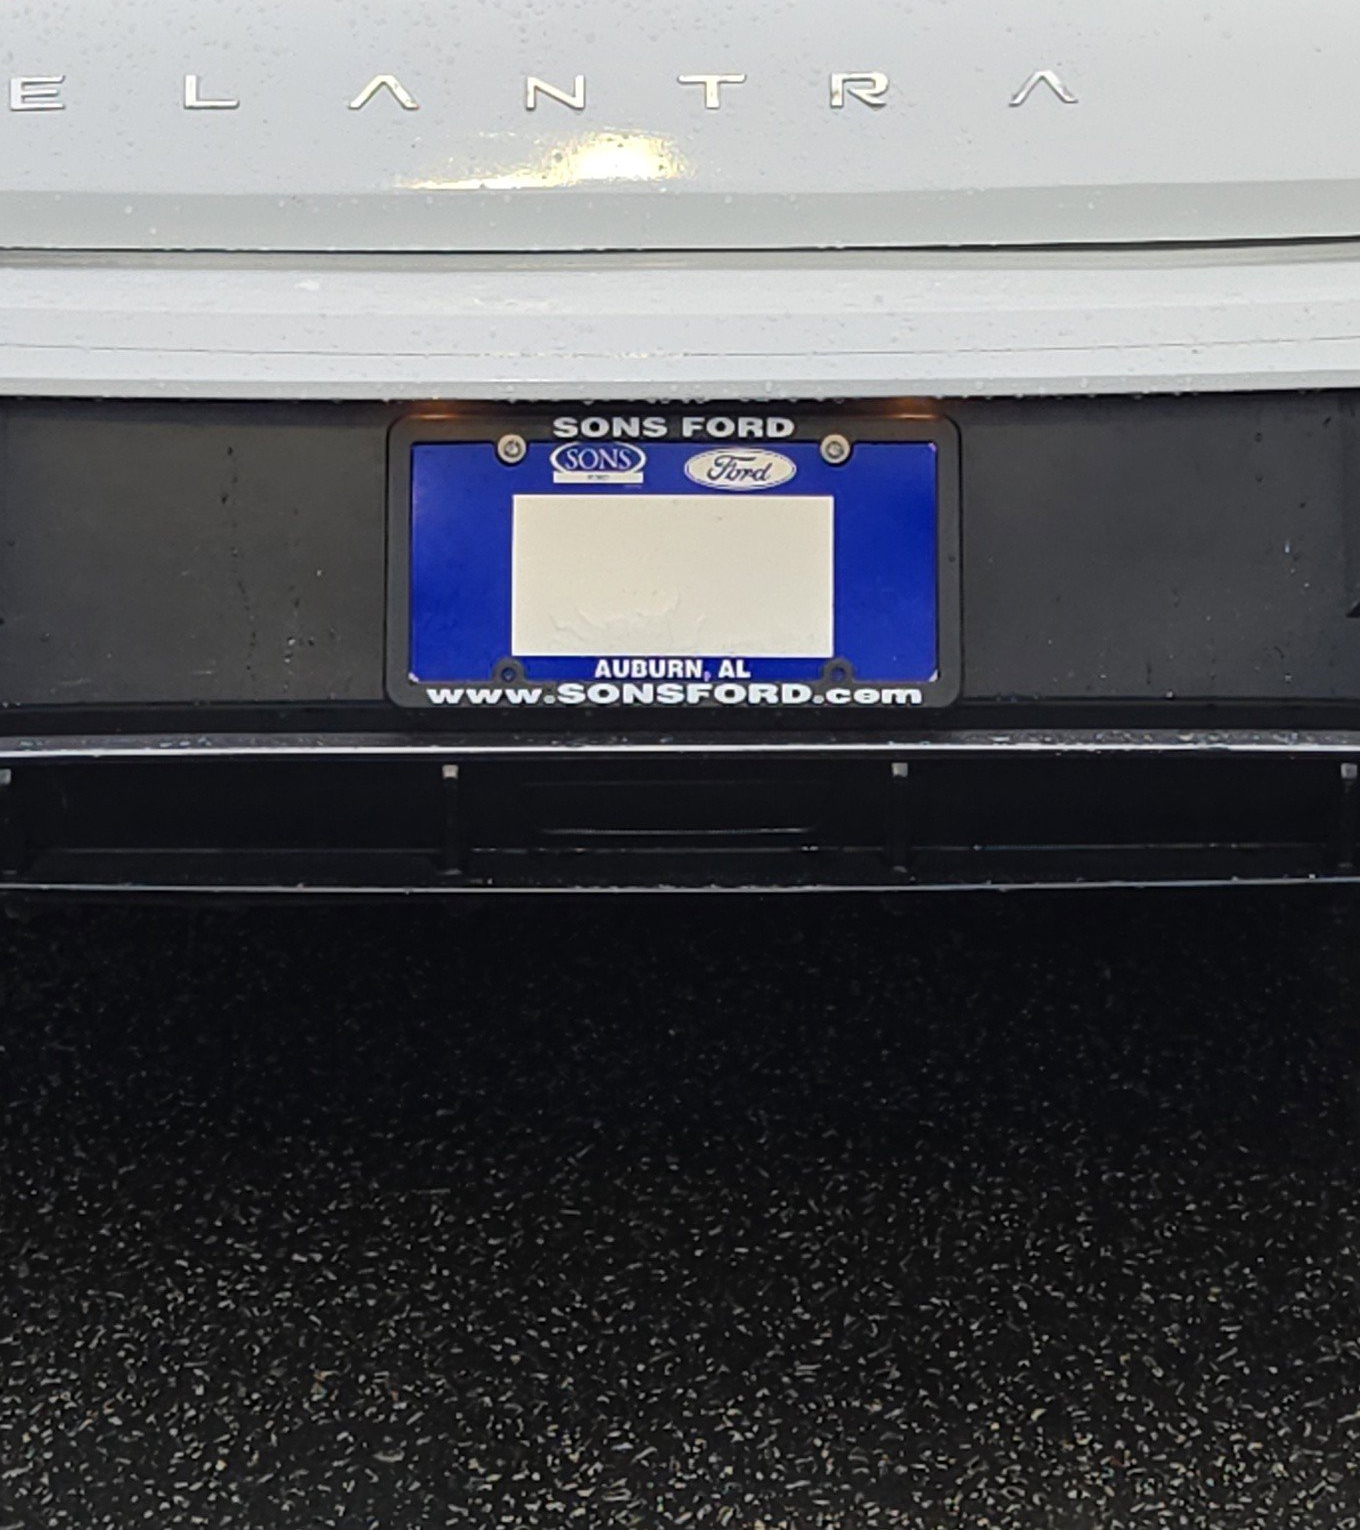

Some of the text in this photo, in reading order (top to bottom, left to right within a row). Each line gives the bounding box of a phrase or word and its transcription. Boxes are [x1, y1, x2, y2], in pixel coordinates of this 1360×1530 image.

[8, 72, 1077, 112] ELANTRA
[552, 416, 795, 438] SONS FORD
[565, 448, 632, 470] SONS
[706, 454, 773, 482] Ford
[595, 659, 751, 682] AUBURN, AL
[427, 683, 922, 705] www.SONSFORD.com
